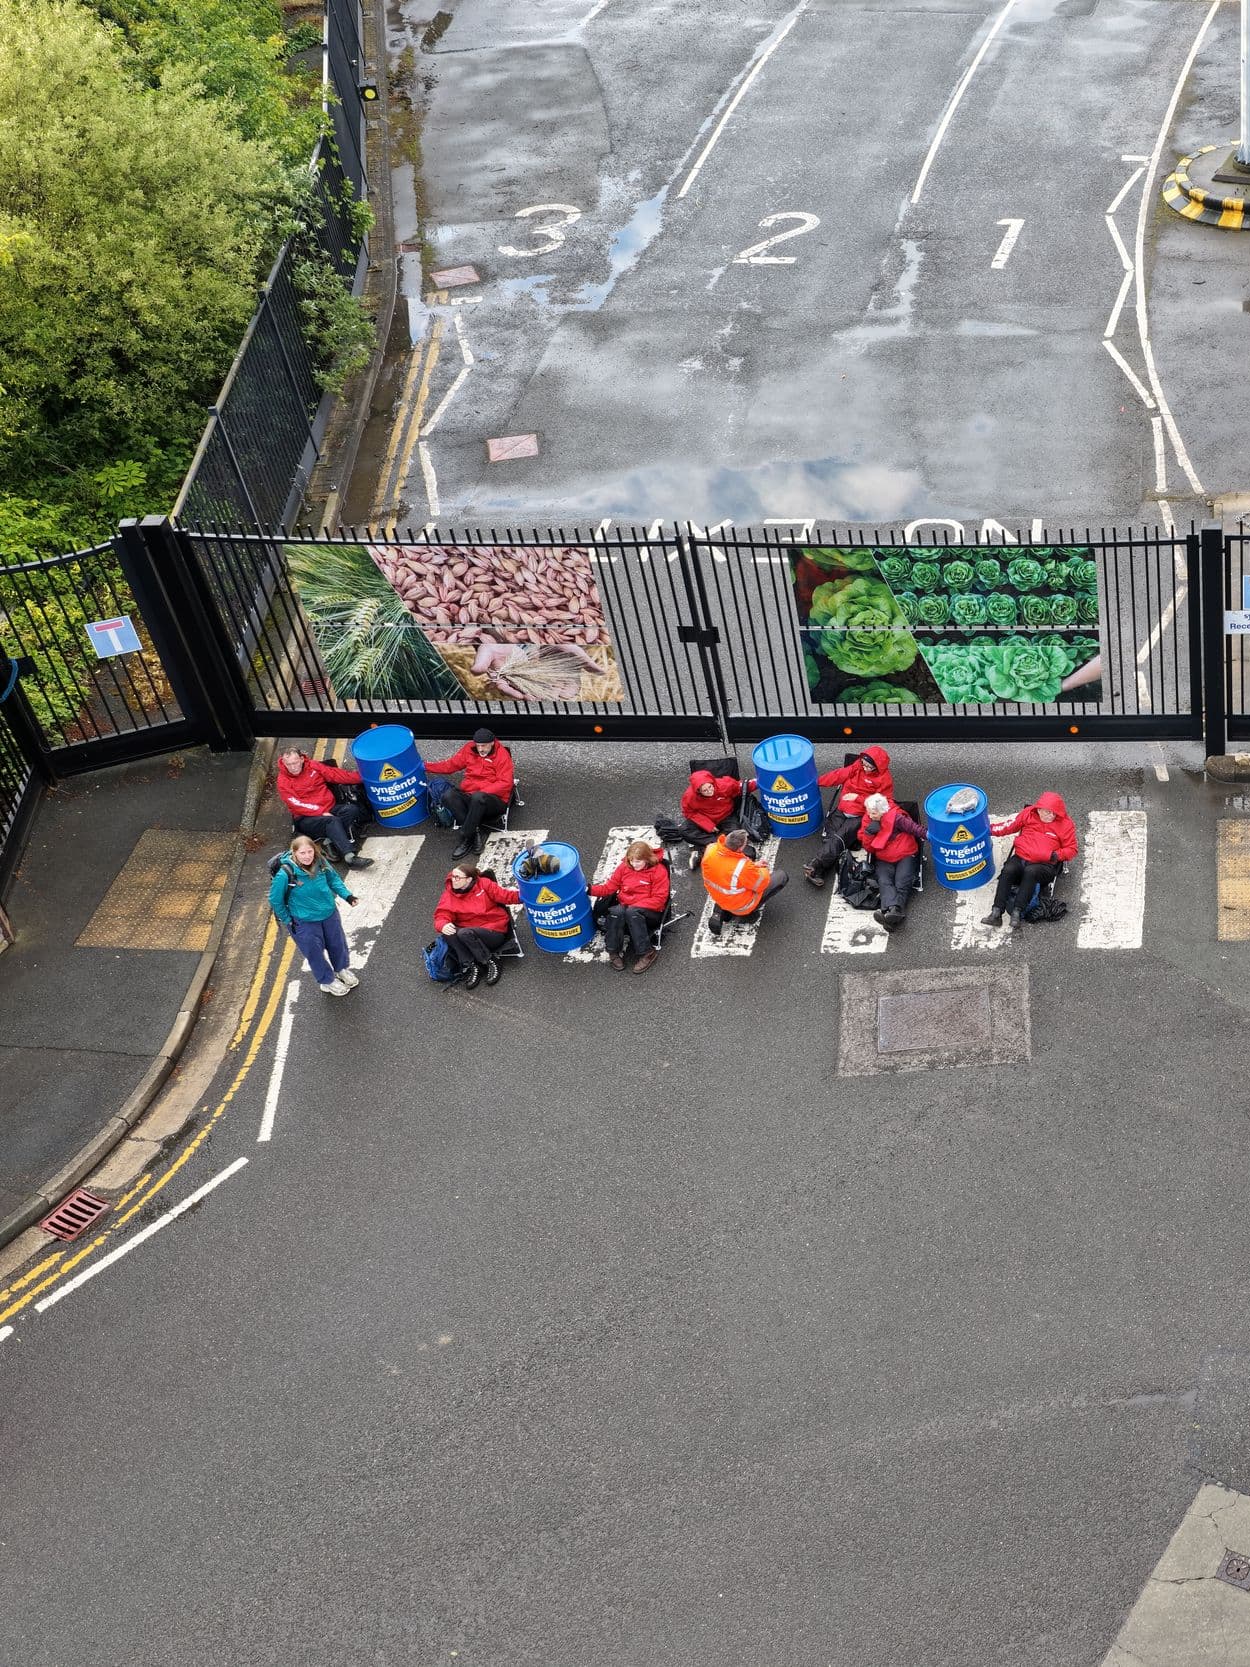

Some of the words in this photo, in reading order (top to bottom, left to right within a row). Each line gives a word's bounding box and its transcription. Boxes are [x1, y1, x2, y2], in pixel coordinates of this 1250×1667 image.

[497, 203, 582, 257] 3
[733, 211, 821, 265] 2
[990, 218, 1025, 269] 1
[370, 776, 417, 796] syngenta
[377, 788, 417, 802] PESTICIDE
[763, 793, 808, 808] syngenta
[767, 804, 805, 813] PESTICIDE
[939, 840, 986, 858] syngenta
[945, 852, 983, 864] PESTICIDE
[527, 902, 577, 920] syngenta
[534, 914, 574, 926] PESTICIDE
